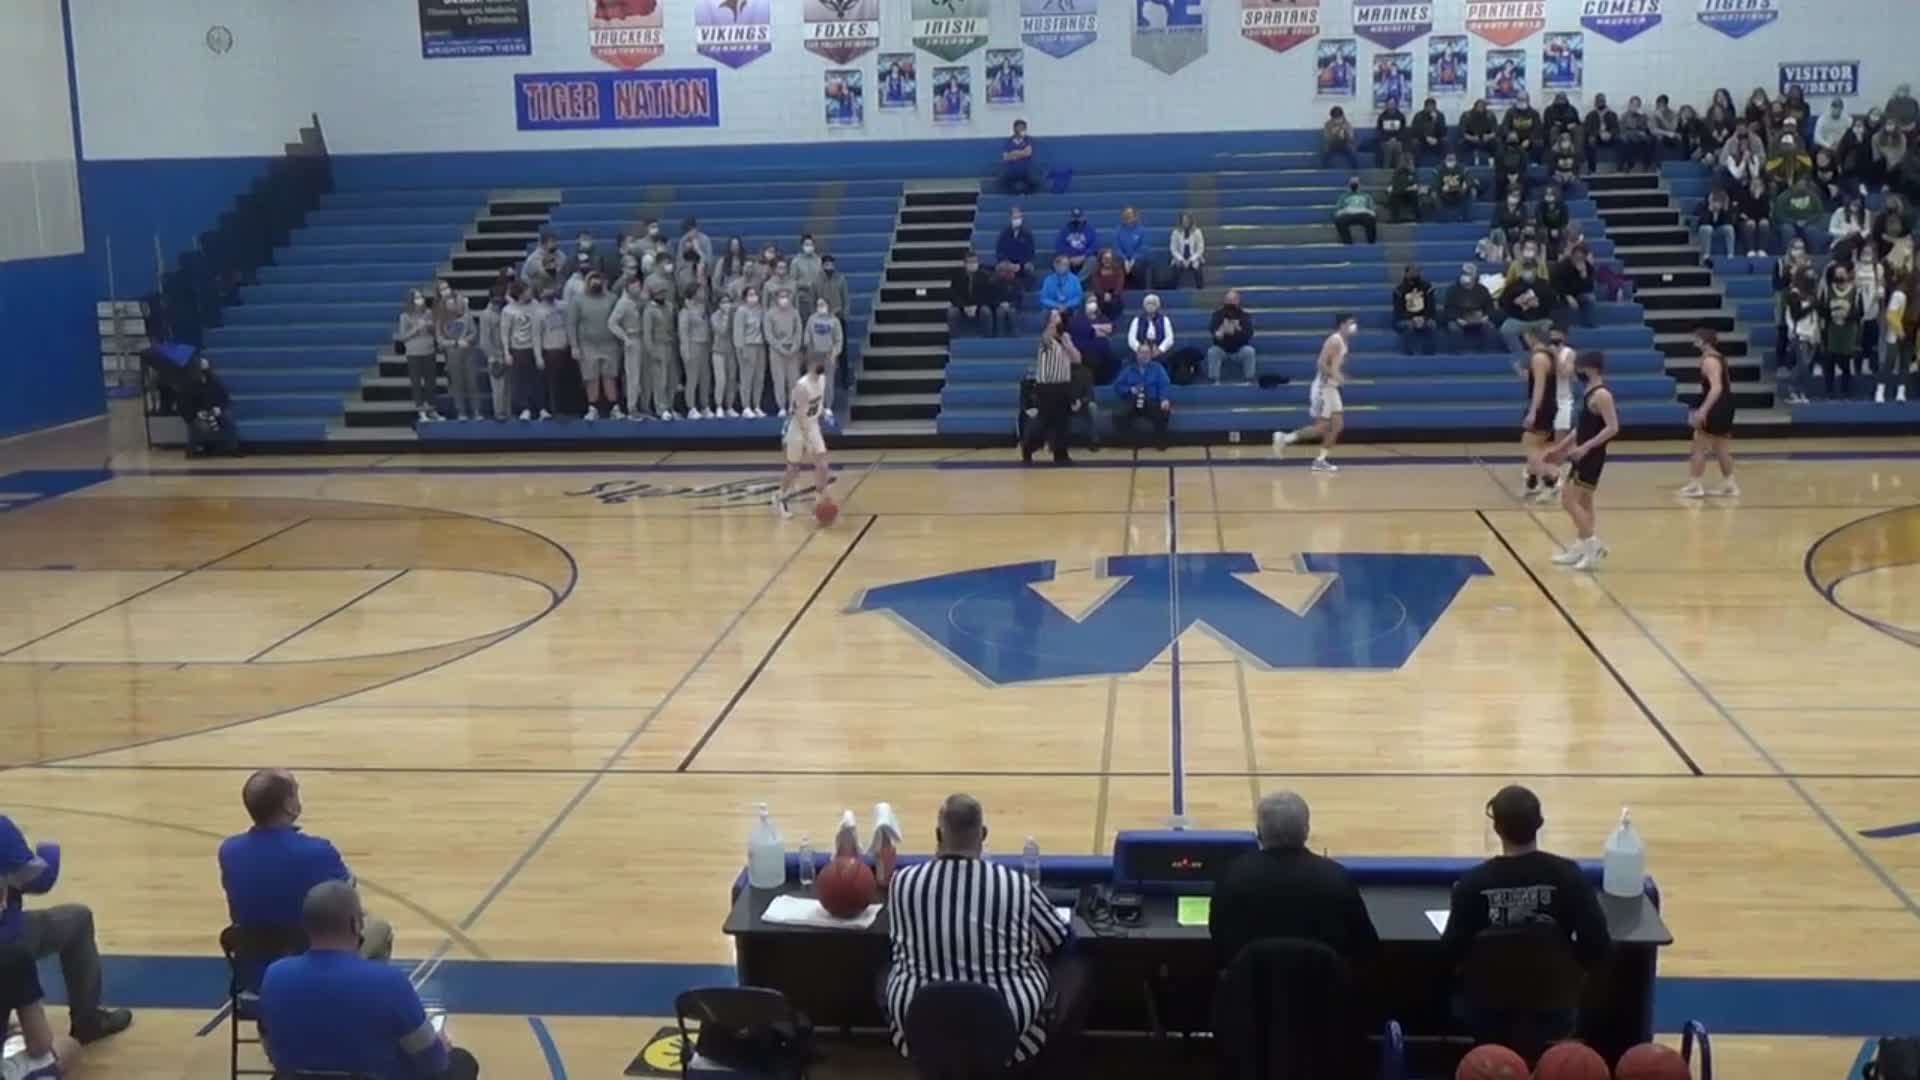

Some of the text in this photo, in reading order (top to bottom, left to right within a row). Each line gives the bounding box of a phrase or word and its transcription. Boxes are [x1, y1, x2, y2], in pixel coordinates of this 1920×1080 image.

[1244, 9, 1318, 25] SPARTANS
[1357, 6, 1429, 22] MARINES
[1468, 3, 1545, 18] PANTHERS
[815, 22, 869, 38] FOXES
[924, 20, 976, 35] IRISH
[1023, 16, 1096, 32] MUSTANGS
[594, 30, 661, 45] TRUCKERS
[701, 26, 768, 41] VIKINGS
[1784, 66, 1853, 81] VISITOR
[524, 77, 711, 122] TIGER NATION
